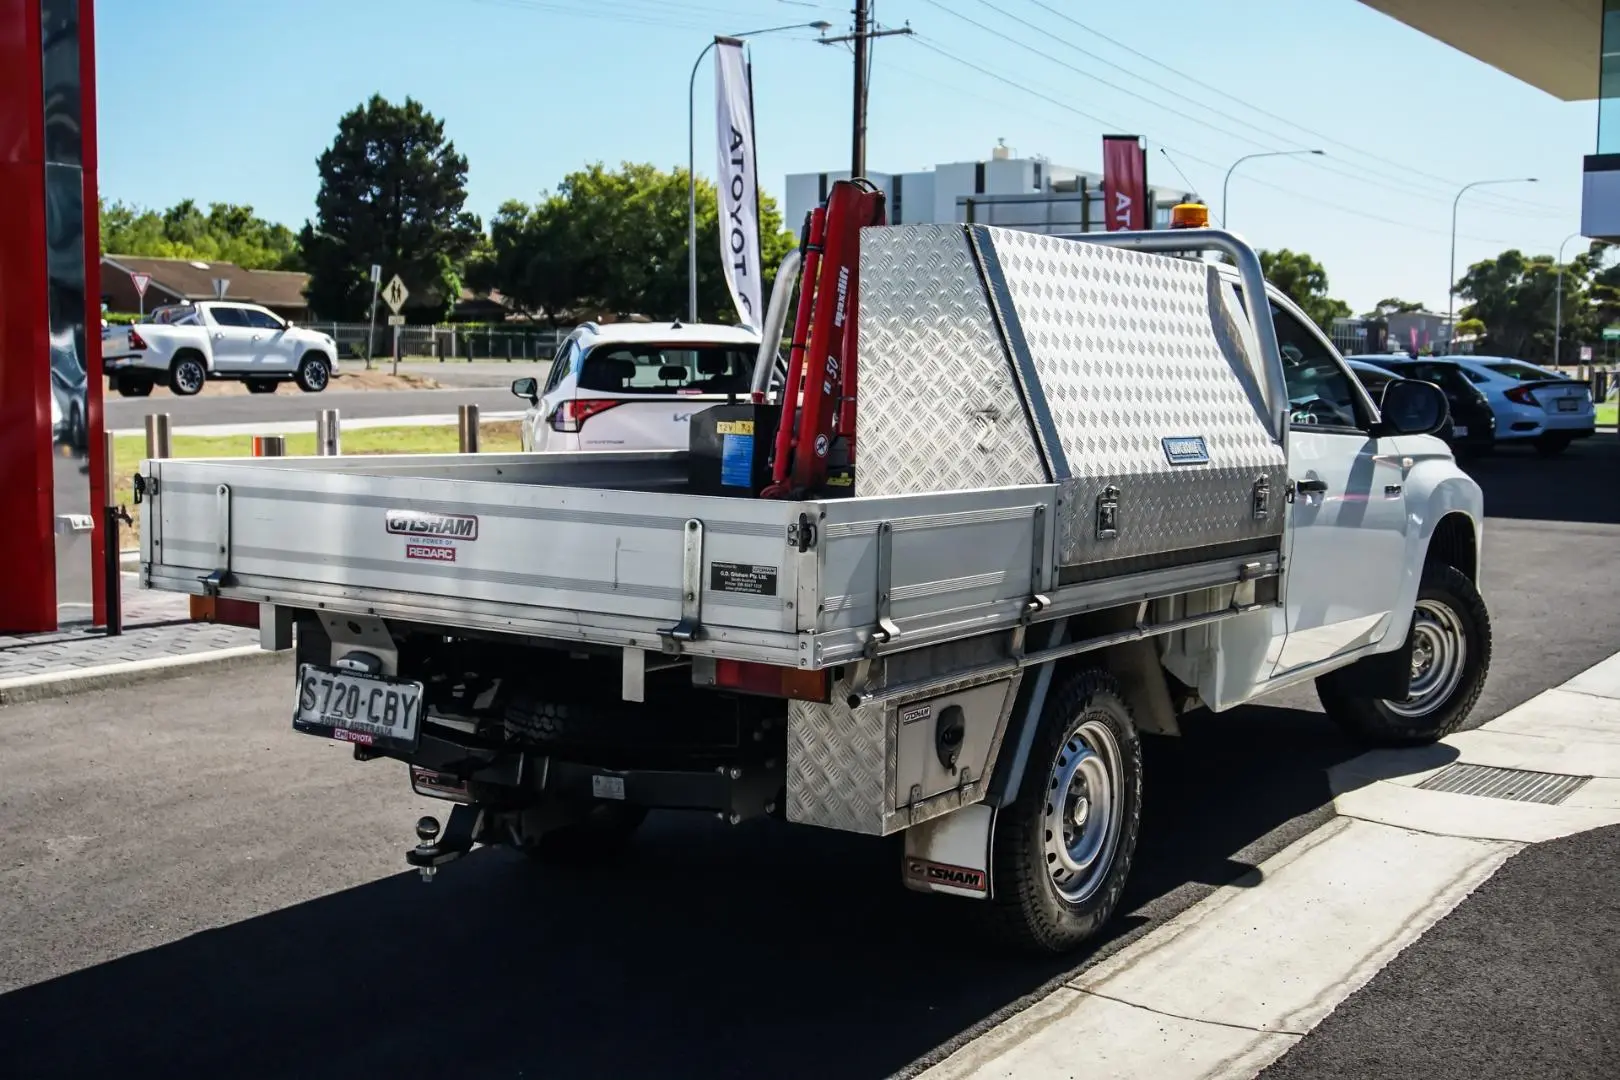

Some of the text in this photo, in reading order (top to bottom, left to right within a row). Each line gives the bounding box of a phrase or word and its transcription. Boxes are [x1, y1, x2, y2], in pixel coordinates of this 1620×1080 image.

[826, 354, 839, 380] 50
[409, 547, 453, 559] REDARC
[320, 715, 392, 736] SOUTH AUSTRALIA
[348, 733, 373, 744] TOYOTA
